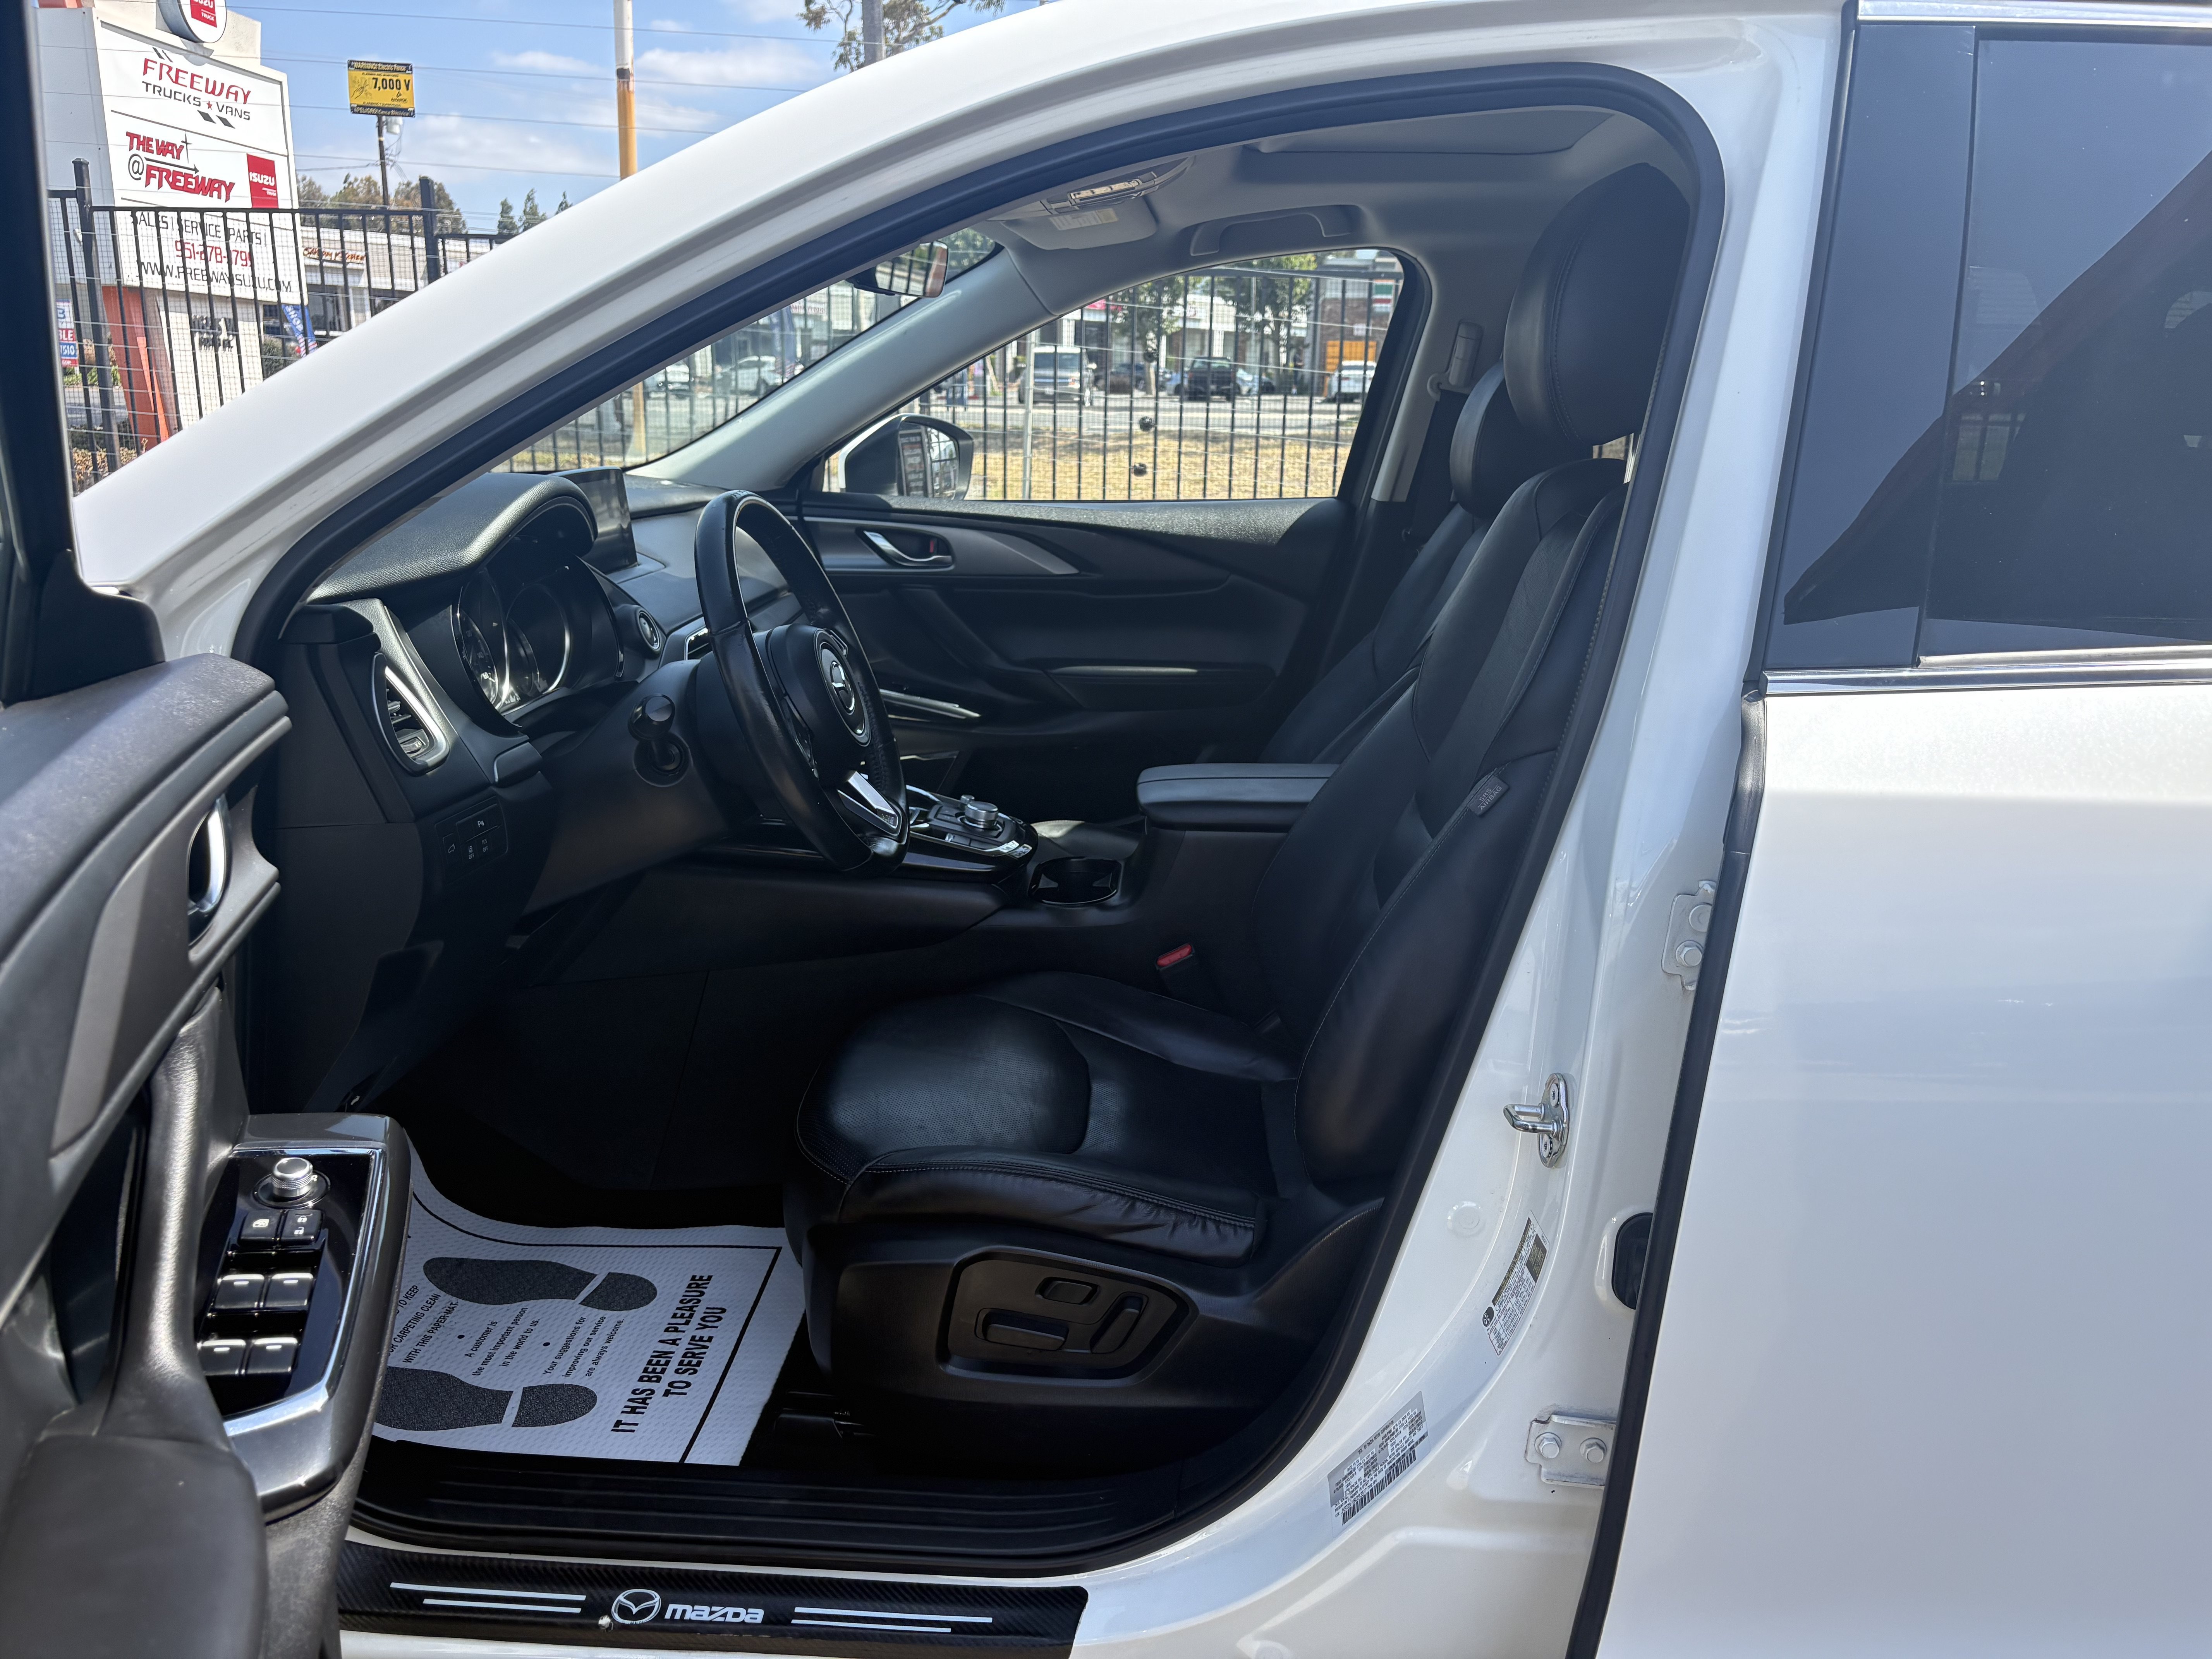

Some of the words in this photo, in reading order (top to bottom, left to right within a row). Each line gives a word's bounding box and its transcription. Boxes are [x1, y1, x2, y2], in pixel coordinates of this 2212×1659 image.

[143, 58, 251, 105] FREEWAY
[372, 77, 401, 91] 7,000
[404, 79, 410, 91] V
[142, 81, 201, 107] TRUCKS
[216, 101, 250, 120] VANS
[126, 131, 154, 154] THE
[155, 139, 185, 160] WAY
[249, 172, 275, 186] ISUZU
[131, 212, 168, 229] ALS
[179, 219, 221, 238] ERICE
[1479, 788, 1491, 801] SRS
[1480, 786, 1502, 810] AIRBAG
[403, 1285, 419, 1300] KEEP
[664, 1275, 713, 1333] PLEASURE
[393, 1312, 425, 1343] CARPETING
[421, 1293, 441, 1312] CLEAN
[697, 1307, 727, 1331] YOU
[402, 1348, 421, 1363] WITH
[416, 1334, 433, 1346] THIS
[471, 1327, 493, 1352] customer
[472, 1367, 484, 1376] the
[481, 1352, 496, 1365] most
[490, 1326, 515, 1351] important
[511, 1308, 528, 1325] person
[505, 1351, 517, 1359] the
[513, 1335, 529, 1349] world
[543, 1361, 558, 1374] Your
[555, 1326, 580, 1360] suggestions
[575, 1317, 586, 1326] for
[562, 1348, 588, 1377] improving
[584, 1337, 593, 1346] our
[590, 1316, 606, 1336] service
[586, 1367, 595, 1377] are
[592, 1346, 608, 1365] always
[605, 1319, 624, 1344] welcome.
[658, 1338, 682, 1346] A
[637, 1350, 675, 1383] BEEN
[674, 1336, 714, 1375] SERVE
[620, 1388, 656, 1415] HAS
[663, 1380, 692, 1397] TO
[611, 1419, 639, 1433] IT
[665, 1603, 764, 1623] mazda
